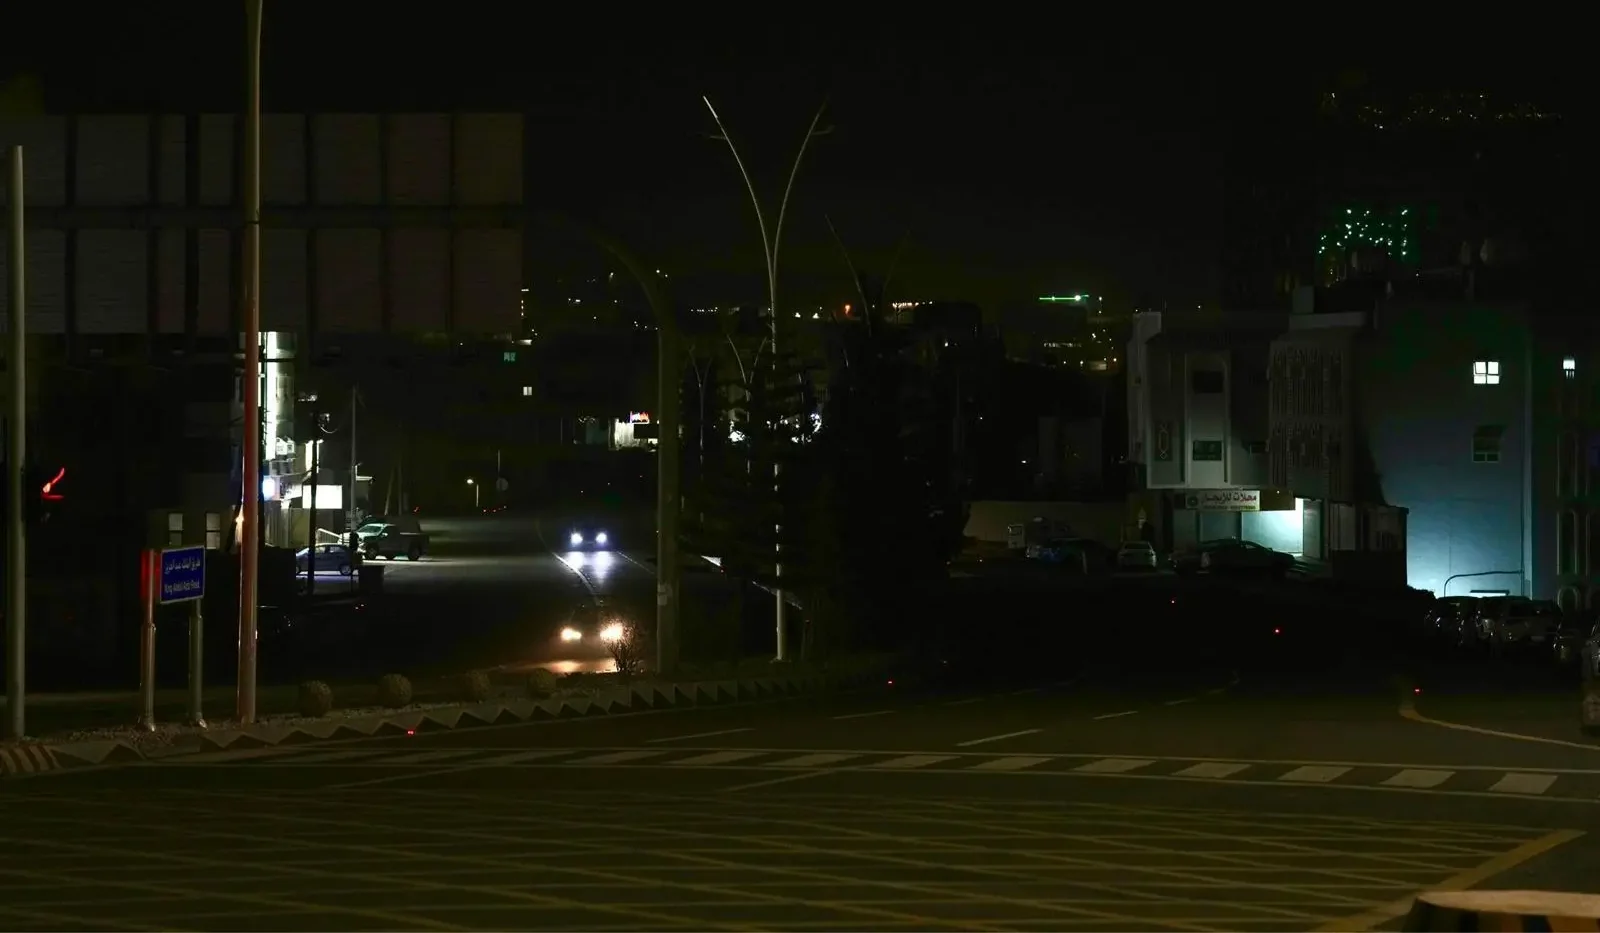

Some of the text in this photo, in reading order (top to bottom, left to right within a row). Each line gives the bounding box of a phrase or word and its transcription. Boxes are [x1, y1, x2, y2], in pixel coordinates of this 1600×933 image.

[1231, 491, 1256, 502] محلات
[181, 556, 191, 570] الملك
[164, 583, 173, 595] King
